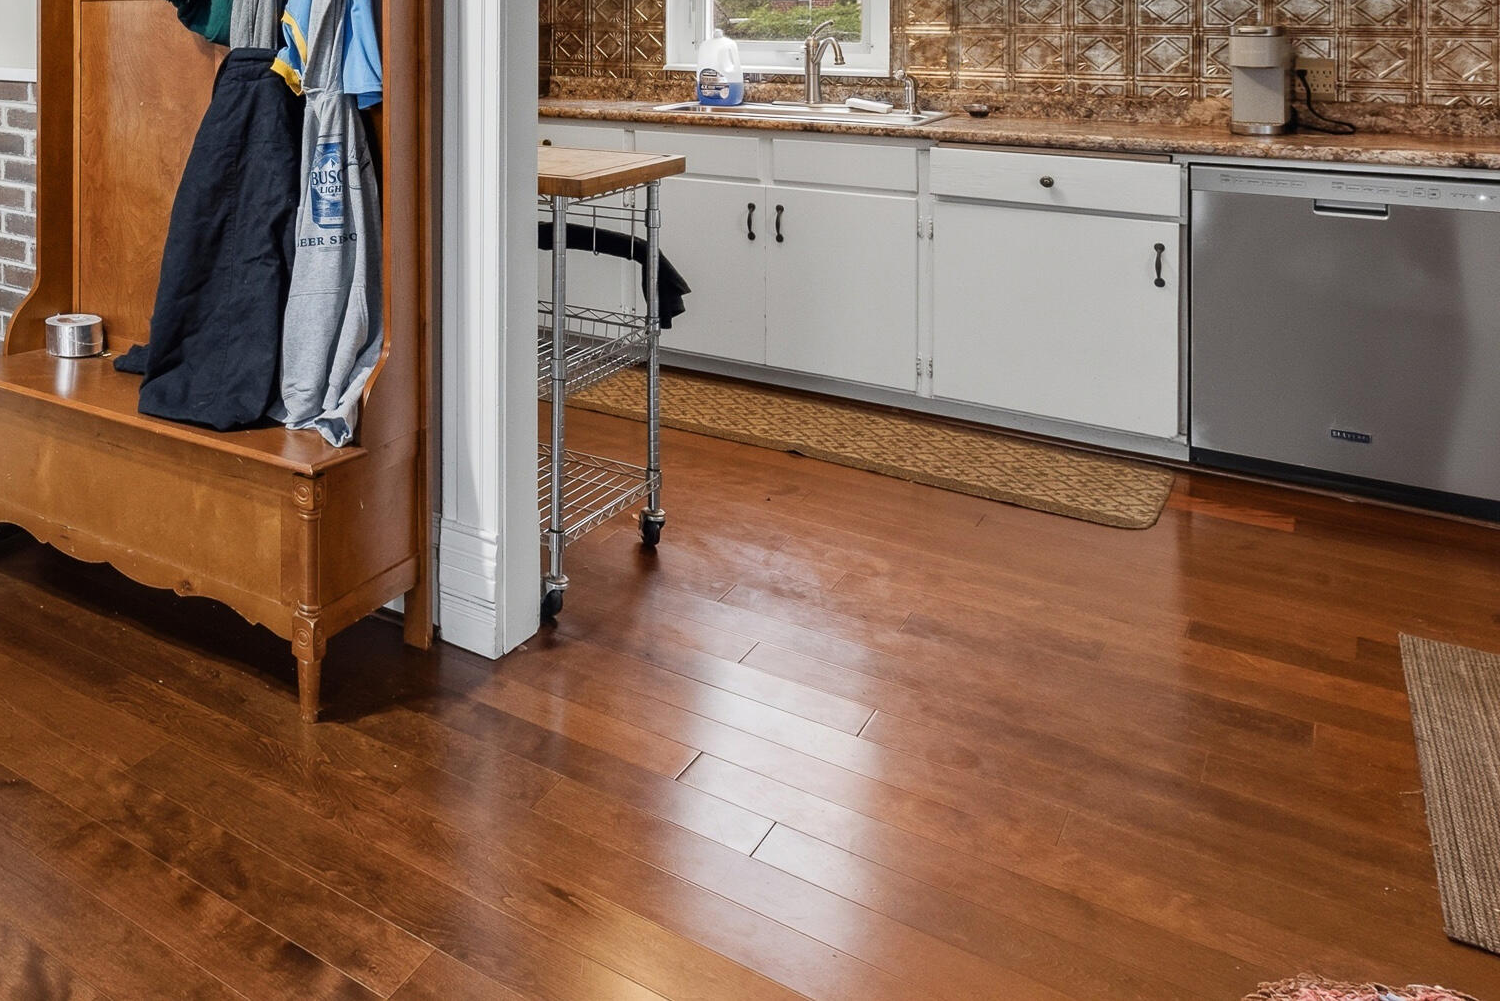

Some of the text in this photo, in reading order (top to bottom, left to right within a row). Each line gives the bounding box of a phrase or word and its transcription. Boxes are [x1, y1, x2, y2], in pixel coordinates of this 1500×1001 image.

[311, 168, 343, 186] BUSC
[319, 184, 343, 194] LIGH
[297, 237, 324, 248] EER
